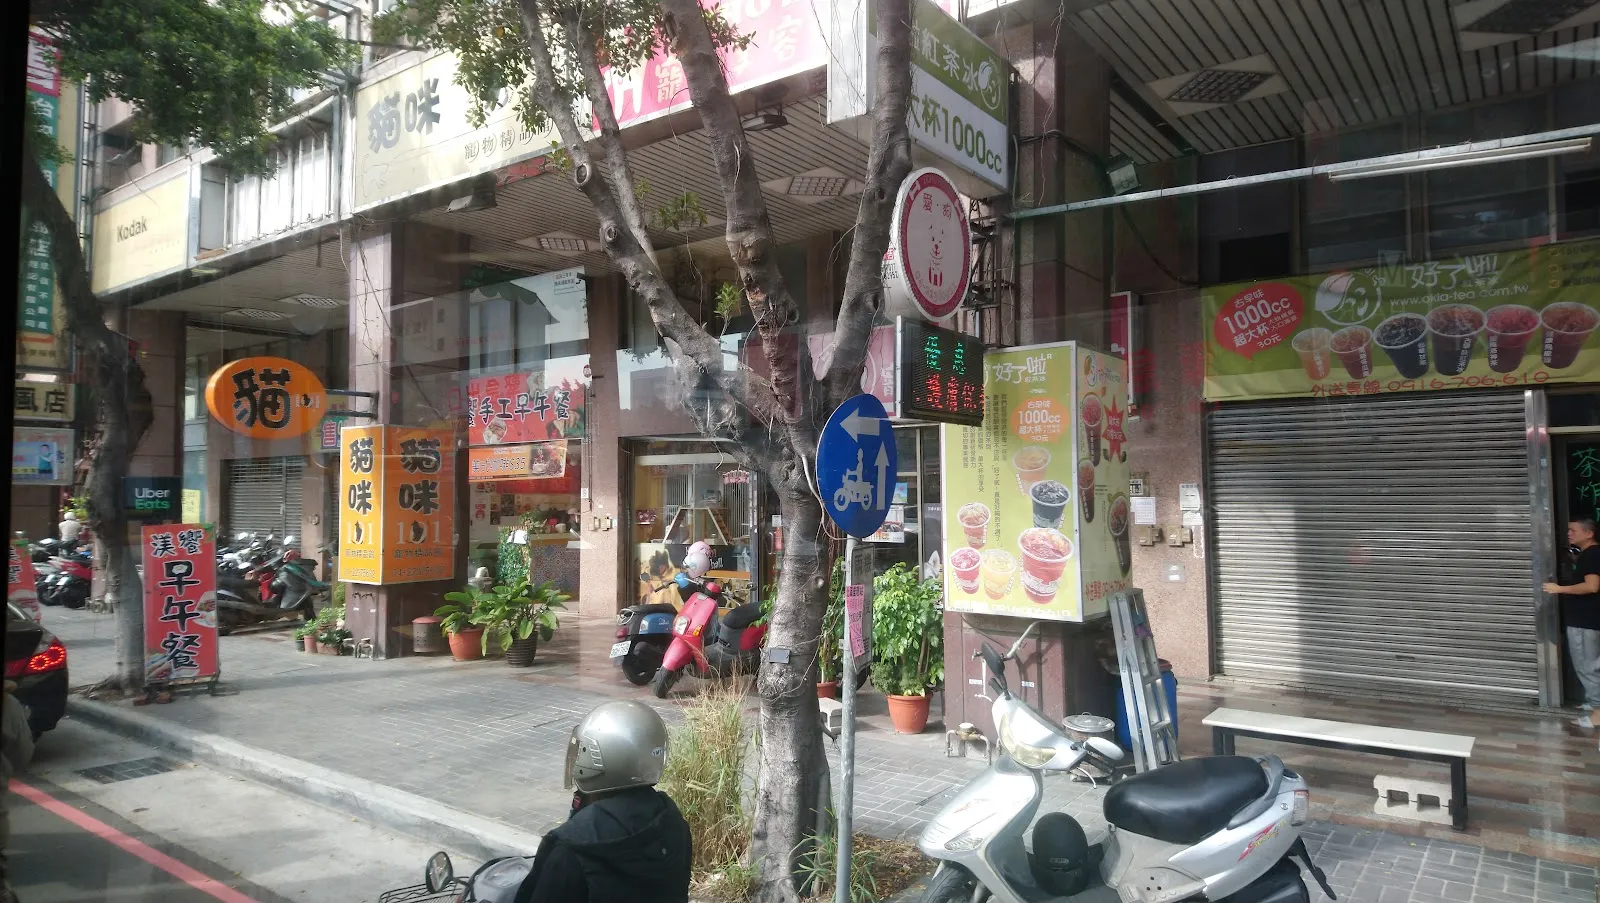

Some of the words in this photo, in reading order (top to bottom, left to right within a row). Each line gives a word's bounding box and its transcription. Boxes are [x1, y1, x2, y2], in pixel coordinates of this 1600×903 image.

[368, 78, 440, 153] 貓咪
[117, 217, 147, 243] Kodak
[1234, 289, 1264, 309] 古早味
[1223, 298, 1291, 334] 1000cc
[1233, 322, 1269, 347] 超大杯
[1257, 333, 1281, 348] 30元
[992, 353, 1047, 384] 好了啦
[1387, 371, 1549, 392] 0916-706-610
[232, 368, 292, 429] 貓
[1018, 409, 1061, 425] 1000cc
[348, 437, 374, 516] 貓咪
[398, 437, 442, 516] 貓咪
[135, 487, 169, 499] Uber
[135, 499, 170, 510] Eats
[159, 561, 201, 669] 早午餐
